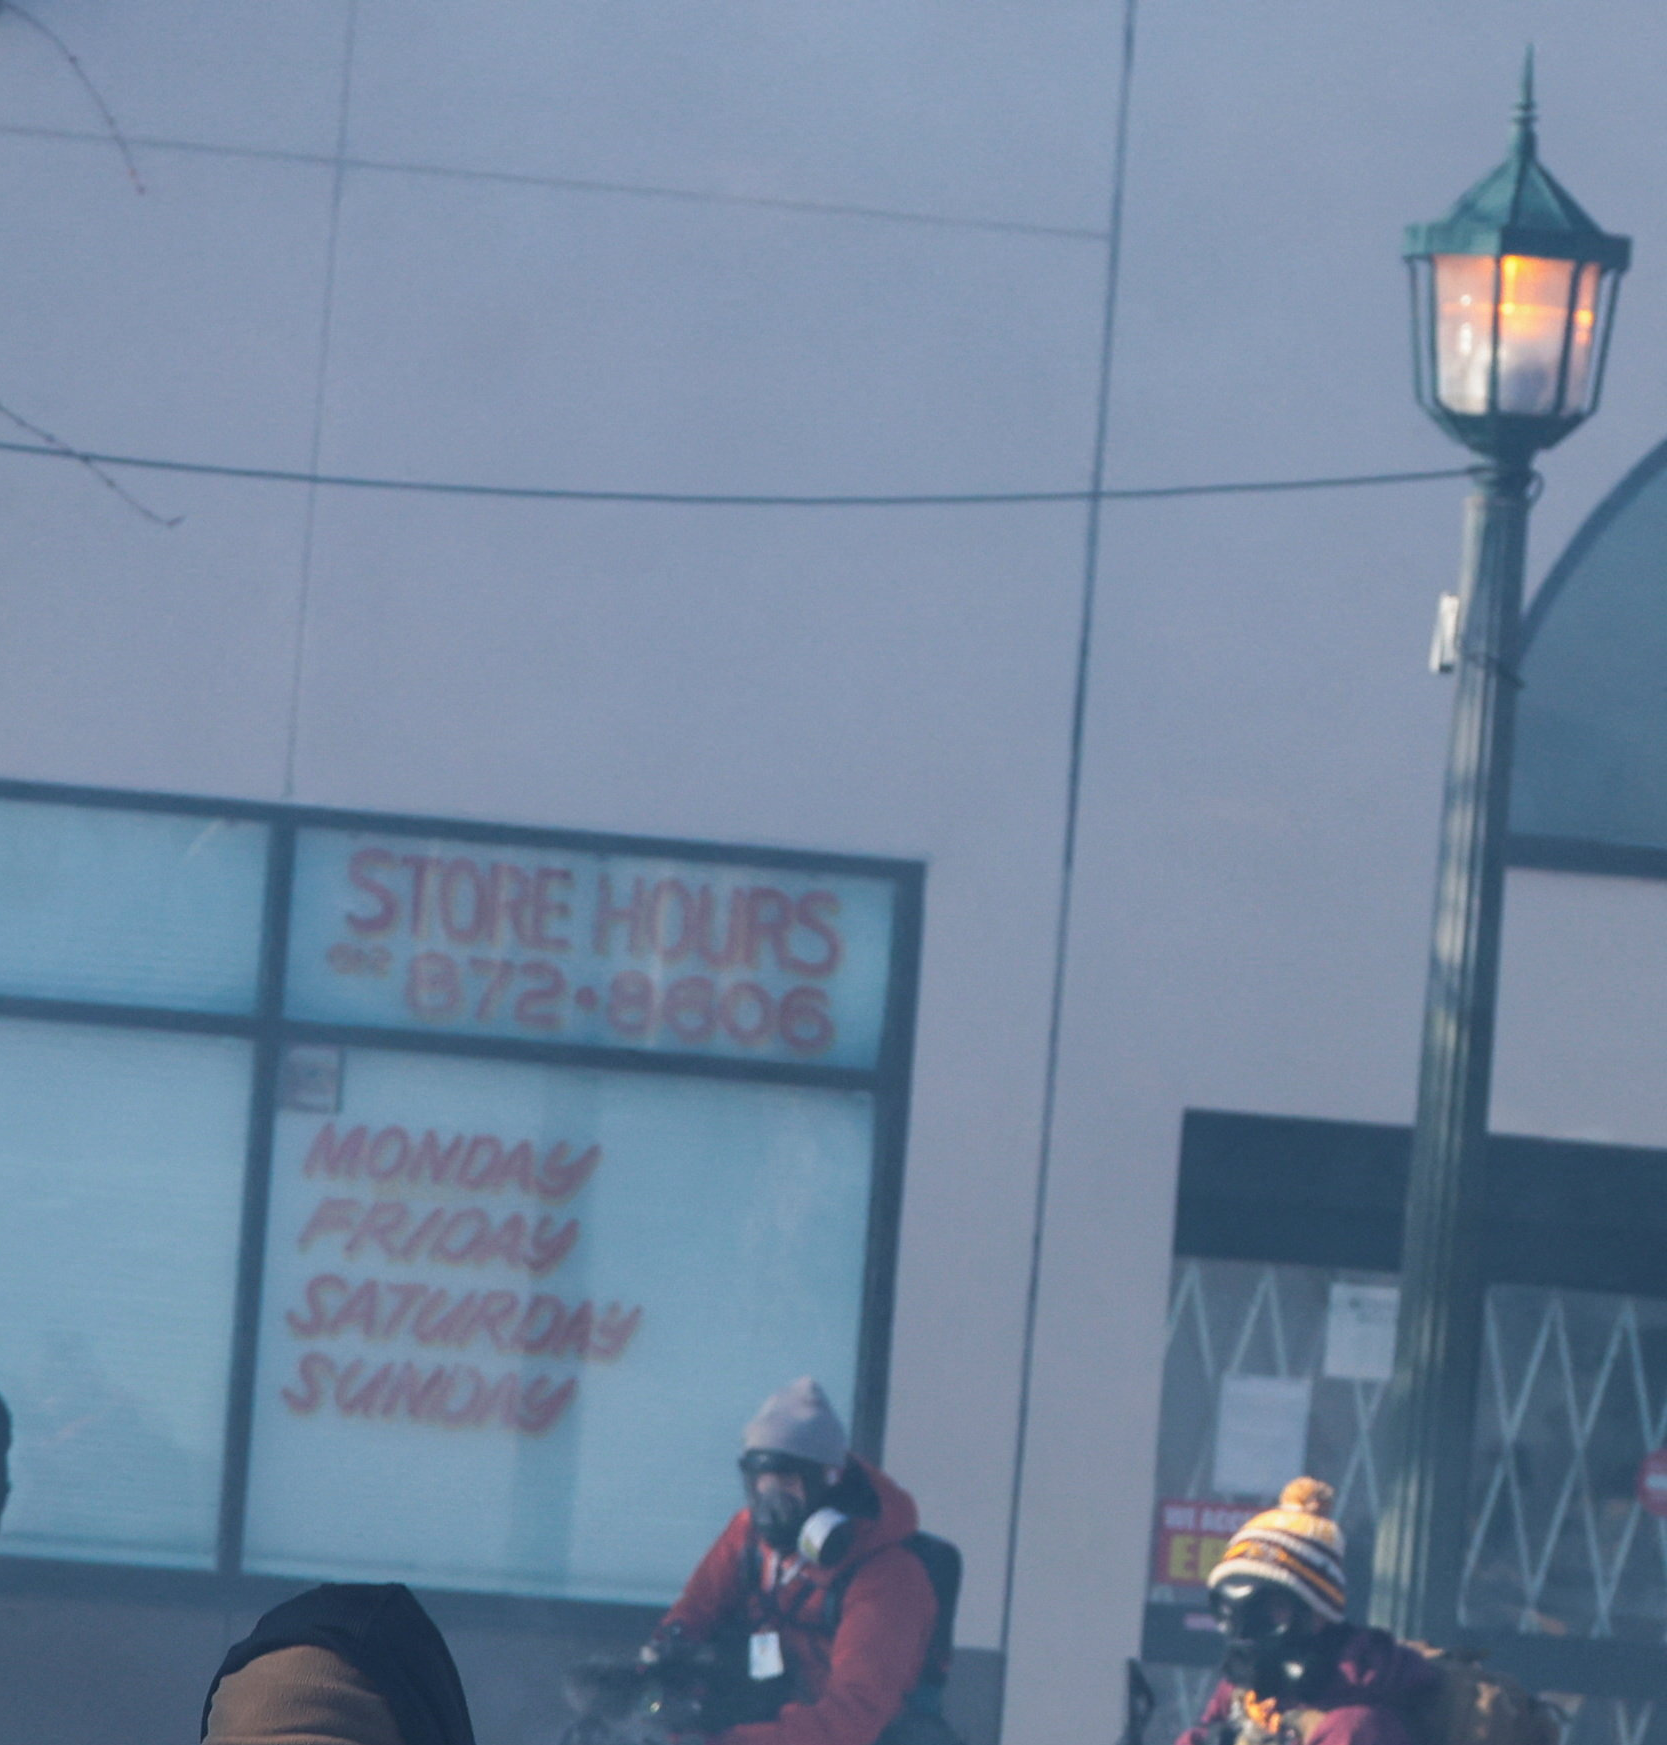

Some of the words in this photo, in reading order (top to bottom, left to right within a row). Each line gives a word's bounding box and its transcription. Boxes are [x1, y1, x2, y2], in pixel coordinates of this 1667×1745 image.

[346, 847, 573, 951] STORE
[592, 872, 844, 979] HOURS
[302, 1121, 603, 1206] MONDAY
[295, 1196, 581, 1278] FRIDAY
[284, 1272, 644, 1363] SATURDAY
[278, 1352, 580, 1438] SUNDAY
